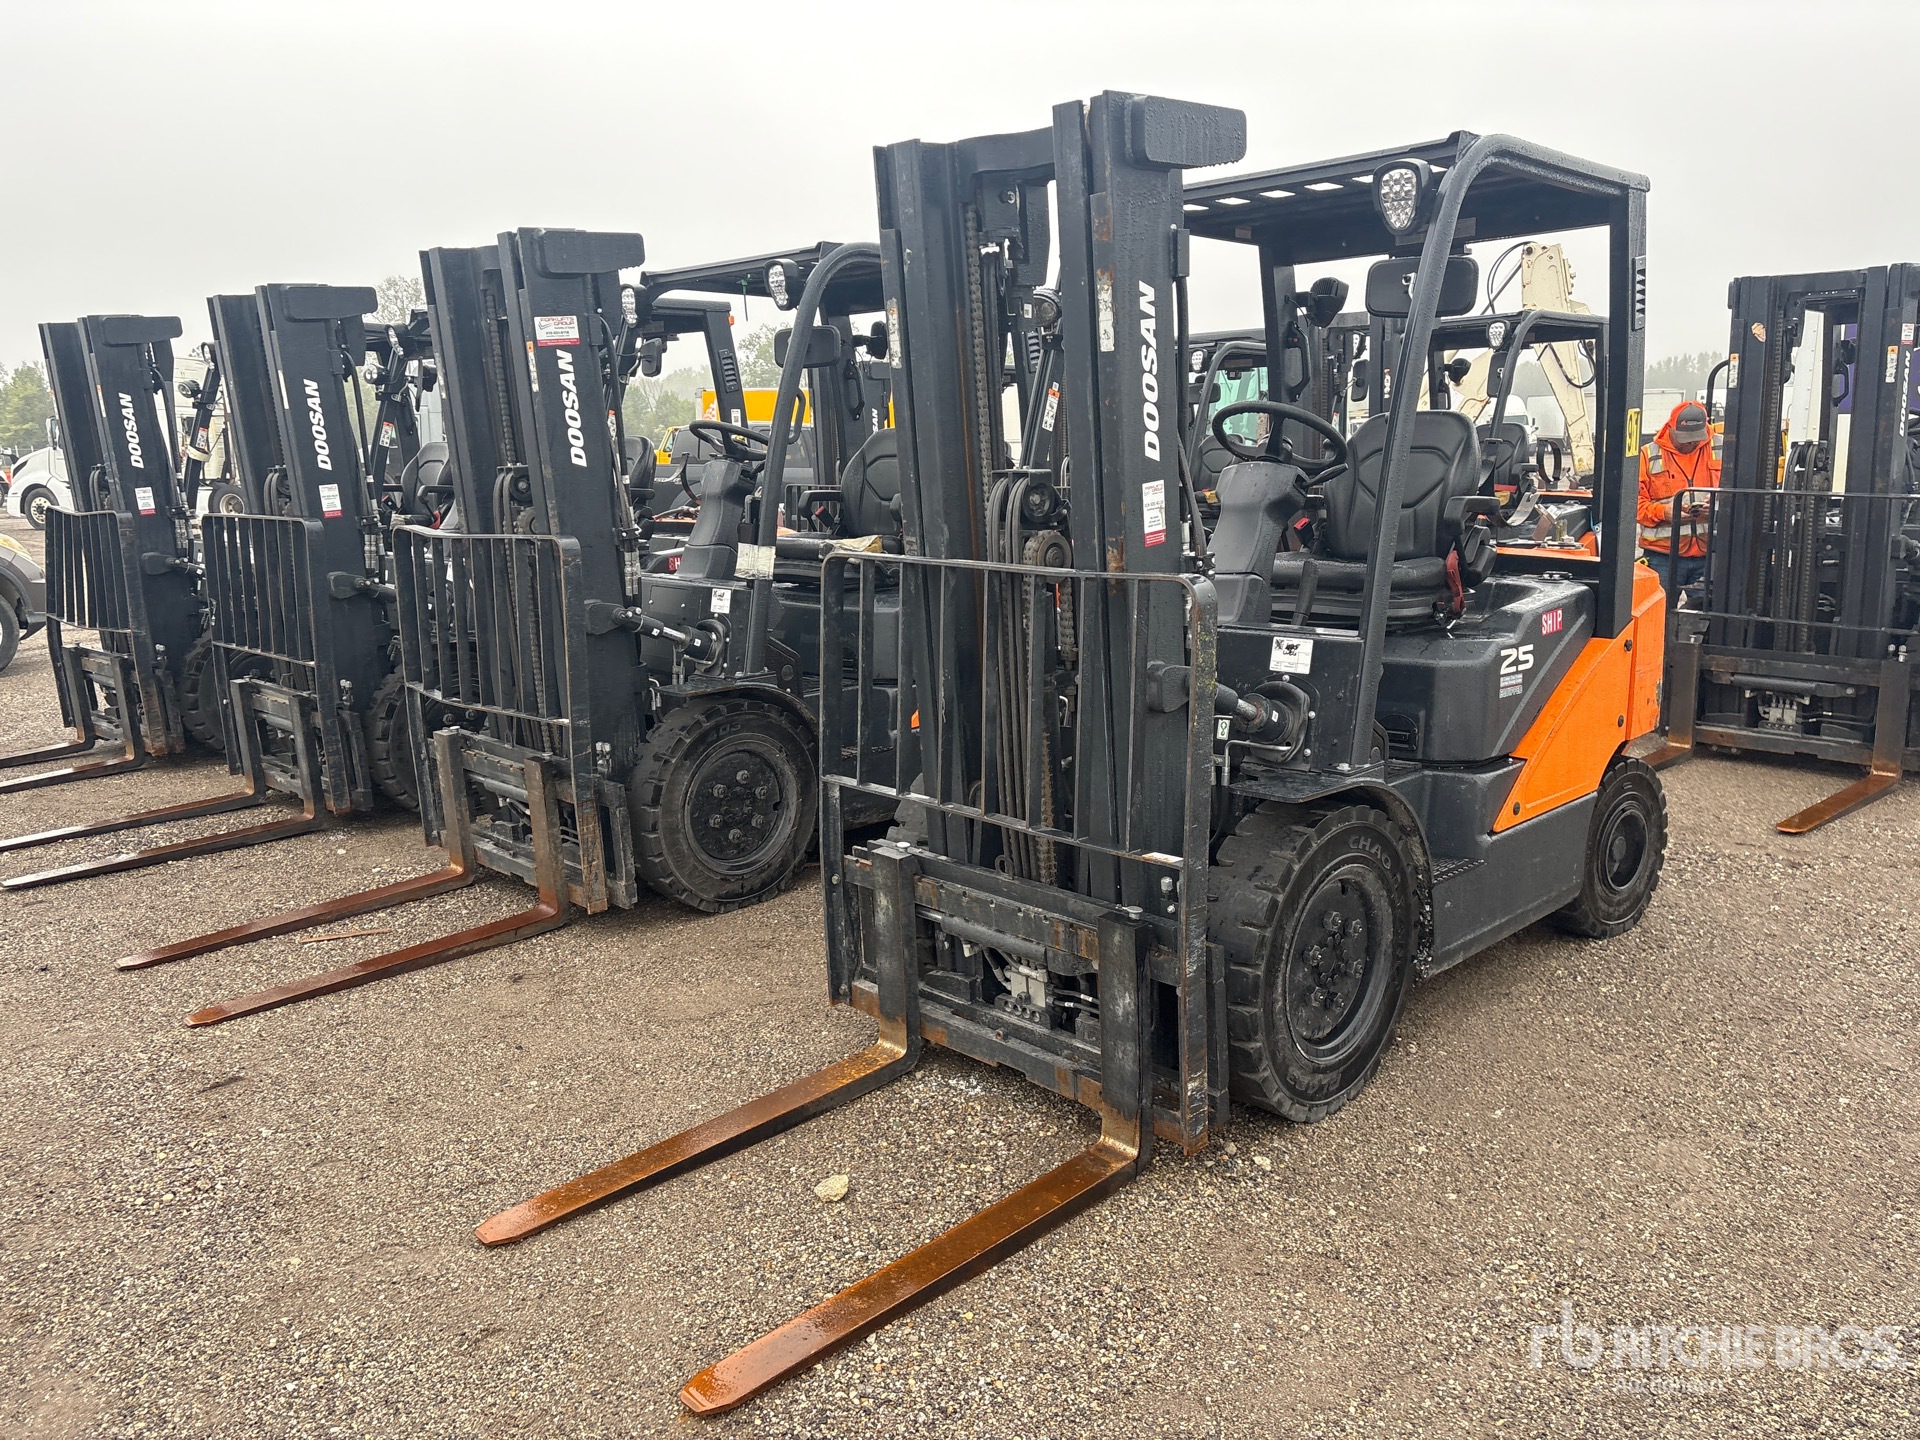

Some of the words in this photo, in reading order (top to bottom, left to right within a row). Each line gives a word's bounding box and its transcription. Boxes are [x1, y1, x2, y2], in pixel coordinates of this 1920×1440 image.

[556, 349, 587, 467] DOOSAN
[1139, 280, 1160, 462] DOOSAN
[1899, 350, 1911, 437] DOOSAN
[118, 392, 144, 469] DOOSAN
[303, 379, 332, 471] DOOSAN
[871, 407, 879, 432] SAN
[1500, 644, 1534, 675] 25
[1541, 609, 1563, 635] SHIP
